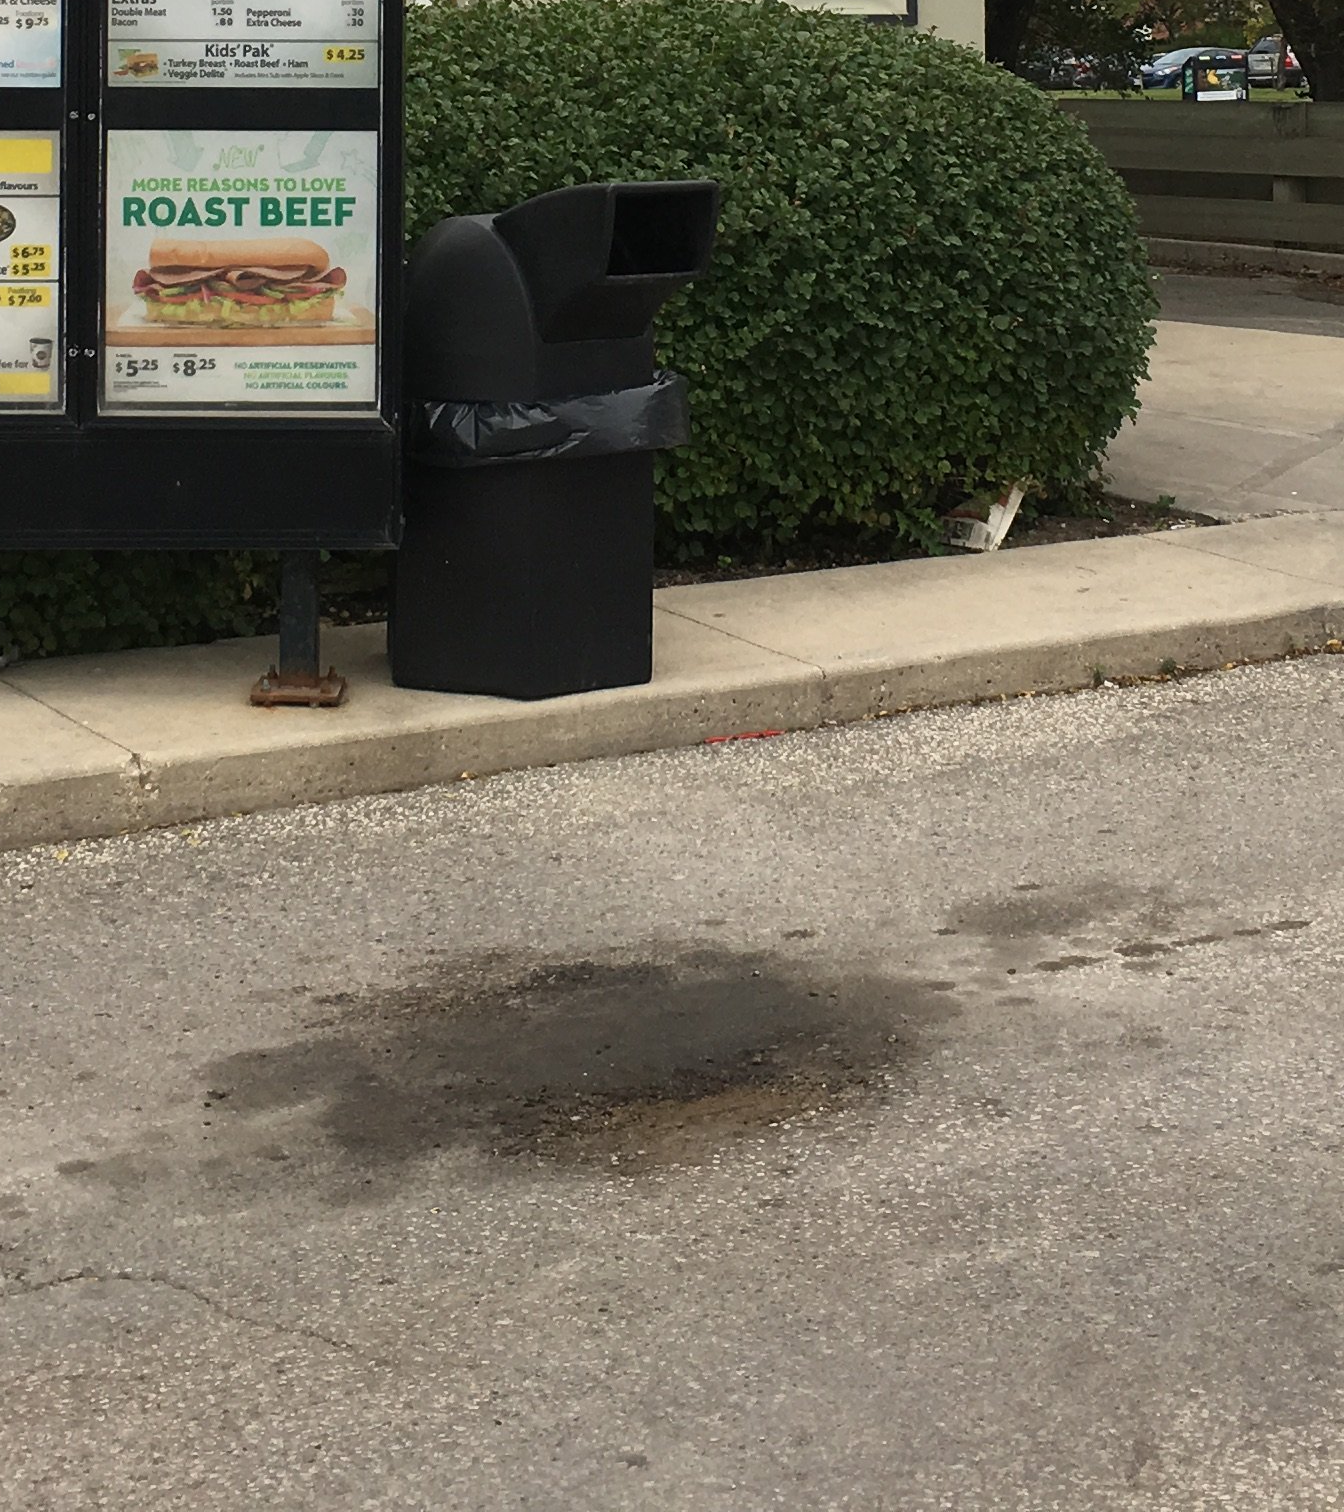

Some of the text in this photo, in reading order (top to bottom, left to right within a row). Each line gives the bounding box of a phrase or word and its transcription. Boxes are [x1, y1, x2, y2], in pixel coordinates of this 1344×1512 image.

[112, 8, 232, 17] Double Meat 1.50
[247, 8, 291, 18] Pepperoni
[112, 18, 137, 27] Bacon
[247, 18, 302, 27] Extra Cheese
[206, 44, 270, 57] Kids' Pak
[168, 59, 226, 69] Turkey Breast
[234, 59, 280, 68] Roast Beef
[288, 60, 308, 68] Ham
[168, 70, 197, 80] Veggie
[215, 145, 259, 169] NEW
[0, 182, 38, 190] flavours
[132, 178, 346, 192] MORE REASONS TO LOVE
[123, 197, 356, 226] ROAST BEEF
[15, 360, 28, 369] for
